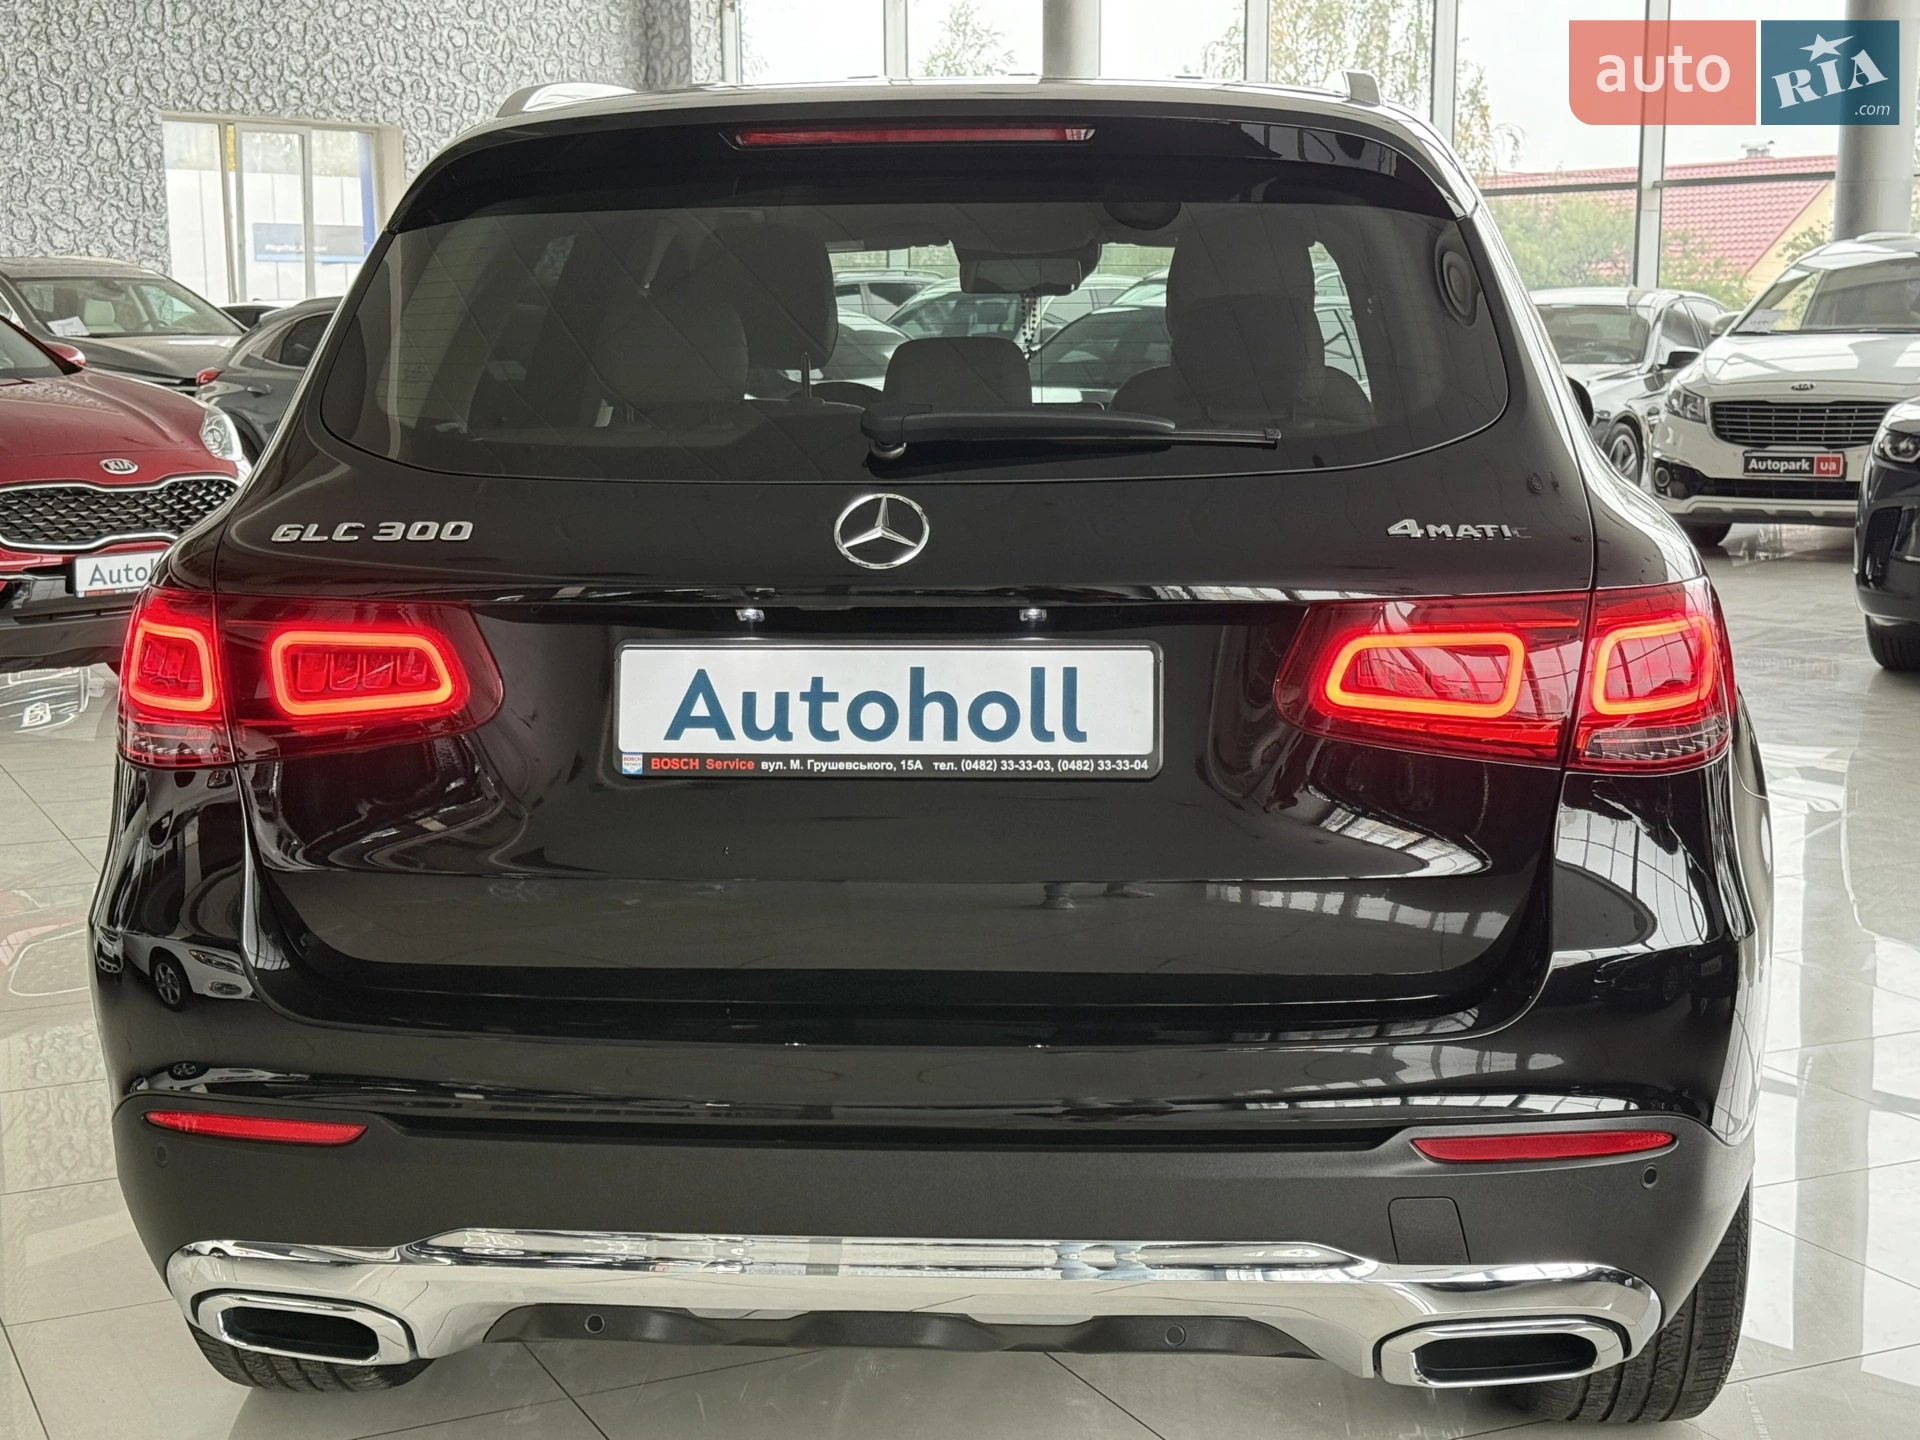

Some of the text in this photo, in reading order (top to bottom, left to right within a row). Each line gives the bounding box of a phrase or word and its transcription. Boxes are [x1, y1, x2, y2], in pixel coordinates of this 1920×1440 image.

[106, 460, 135, 472] KIA
[1748, 458, 1837, 473] Autopark ua
[271, 521, 474, 542] GLC 300
[663, 666, 1087, 742] Autoholl
[651, 757, 699, 770] BOSCH
[705, 758, 755, 770] Service
[761, 761, 787, 772] вул.
[807, 759, 897, 772] Грушевського,
[932, 761, 958, 771] тел.
[960, 759, 998, 772] (0482)
[1000, 759, 1055, 773] 33-33-03,
[1057, 759, 1095, 772] (0482)
[1097, 759, 1149, 771] 33-33-04
